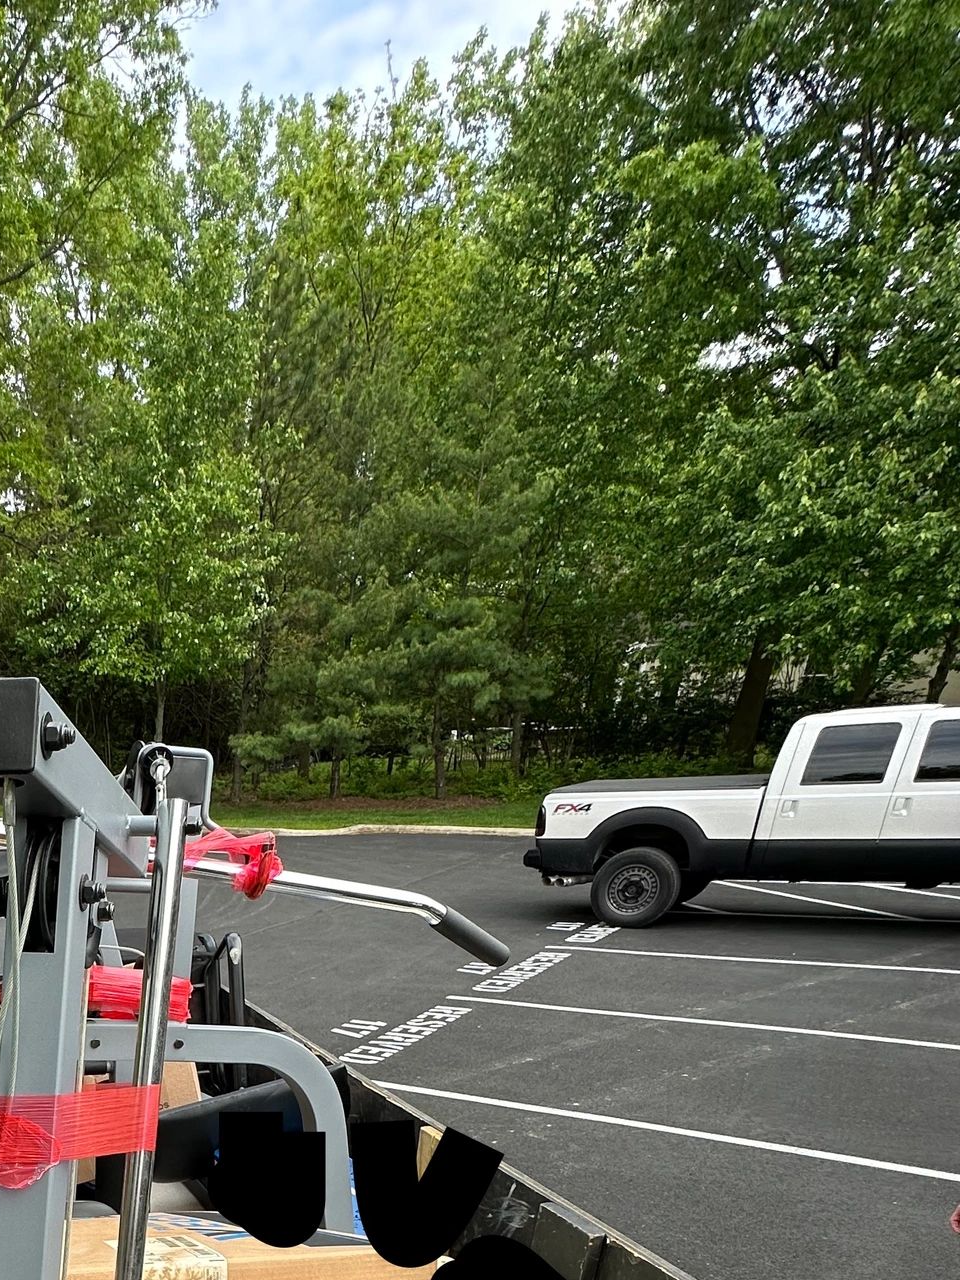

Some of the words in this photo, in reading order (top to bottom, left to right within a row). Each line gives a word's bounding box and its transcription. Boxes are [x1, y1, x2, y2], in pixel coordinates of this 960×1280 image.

[553, 803, 593, 813] FX4
[472, 951, 572, 993] RESERVED
[330, 1019, 388, 1039] 117
[338, 1005, 473, 1065] RESERVED
